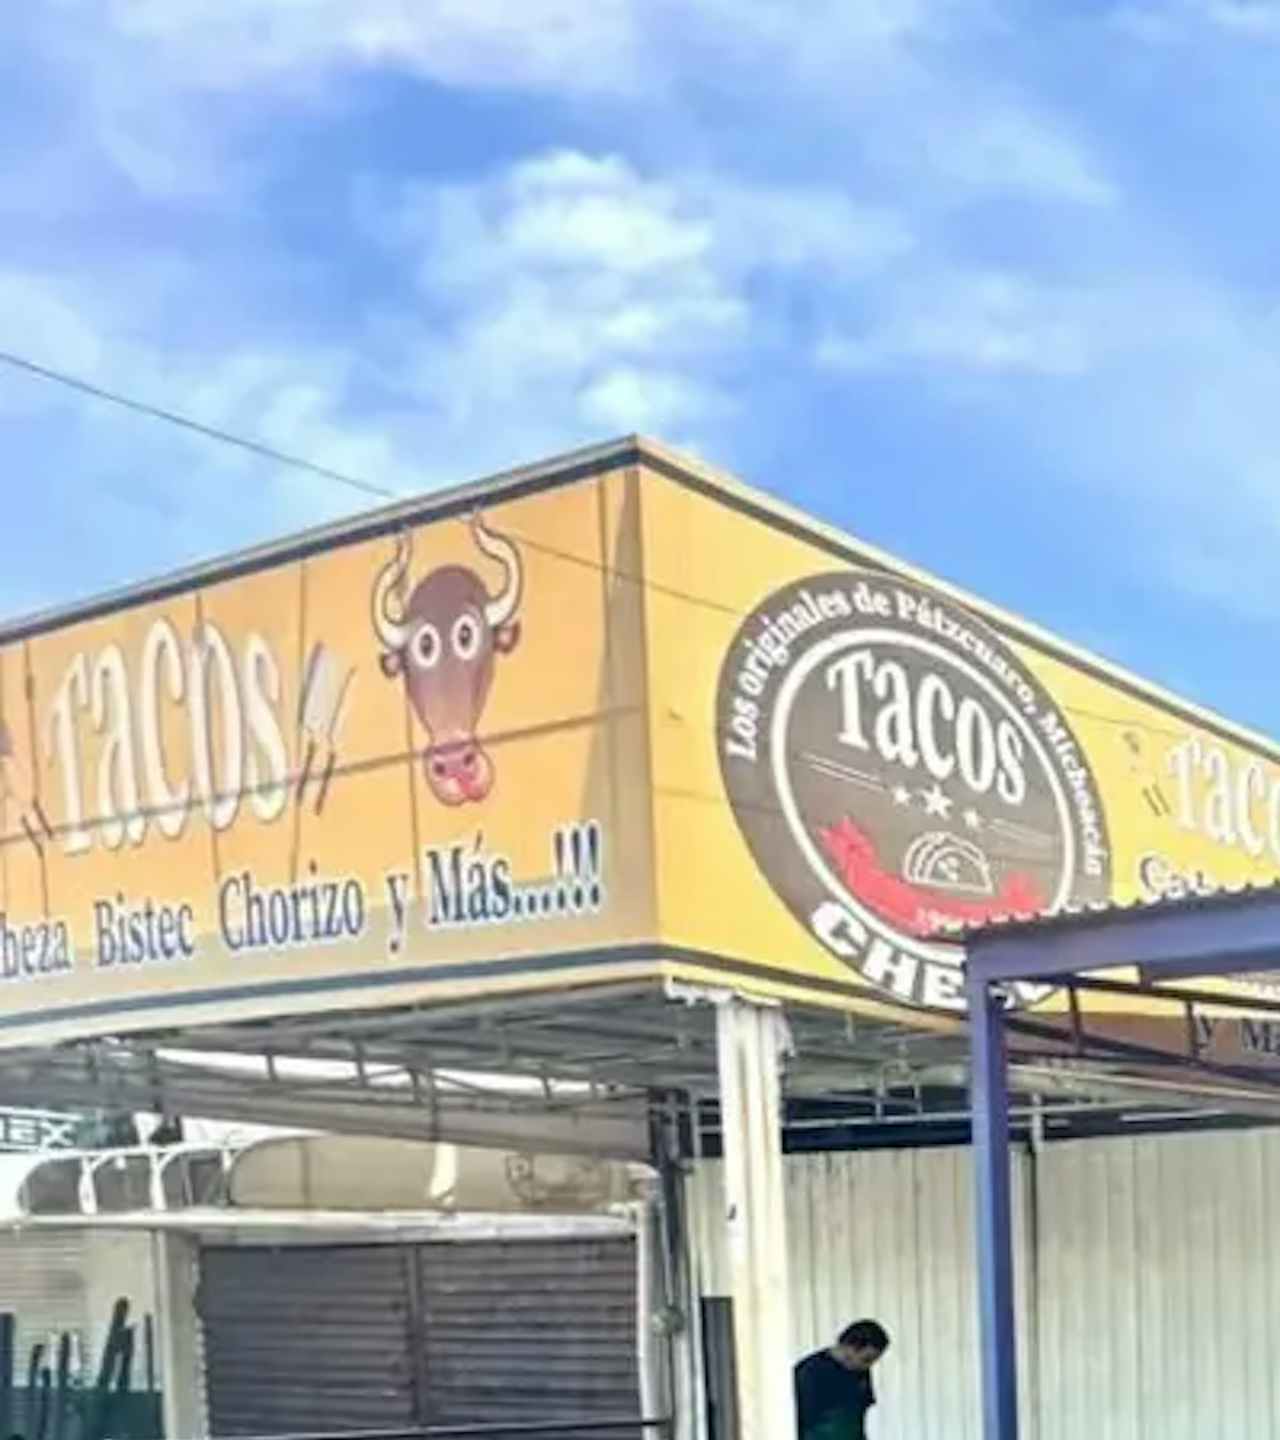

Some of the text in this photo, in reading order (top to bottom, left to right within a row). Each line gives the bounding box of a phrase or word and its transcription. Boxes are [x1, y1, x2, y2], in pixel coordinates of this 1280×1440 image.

[853, 581, 891, 616] de
[740, 588, 854, 697] originales
[726, 703, 760, 760] Los
[0, 912, 72, 979] beza
[93, 890, 195, 967] Bistec
[217, 858, 365, 951] Chorizo
[386, 872, 410, 954] y
